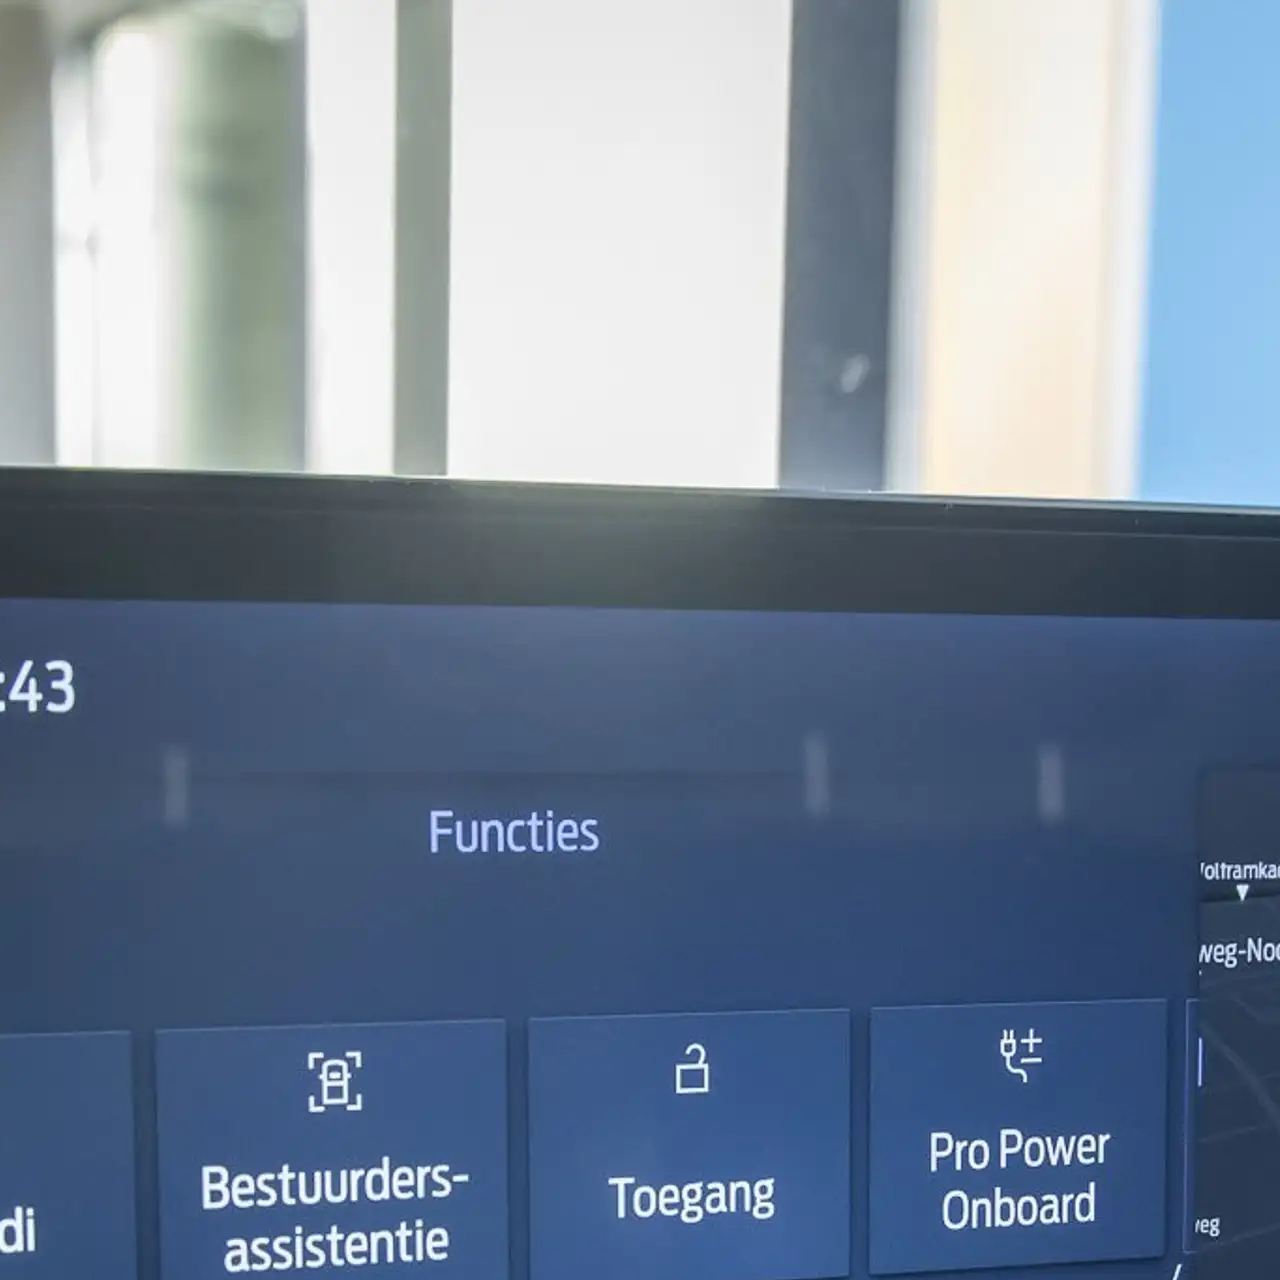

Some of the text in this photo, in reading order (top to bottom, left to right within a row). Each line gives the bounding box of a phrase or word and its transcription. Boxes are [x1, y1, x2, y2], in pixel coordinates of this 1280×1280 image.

[430, 809, 600, 853] Functies
[930, 1128, 1111, 1173] Pro Power
[201, 1155, 469, 1210] Bestuurders-
[607, 1176, 775, 1224] Toegang
[942, 1181, 1096, 1230] Onboard
[223, 1218, 450, 1273] assistentie
